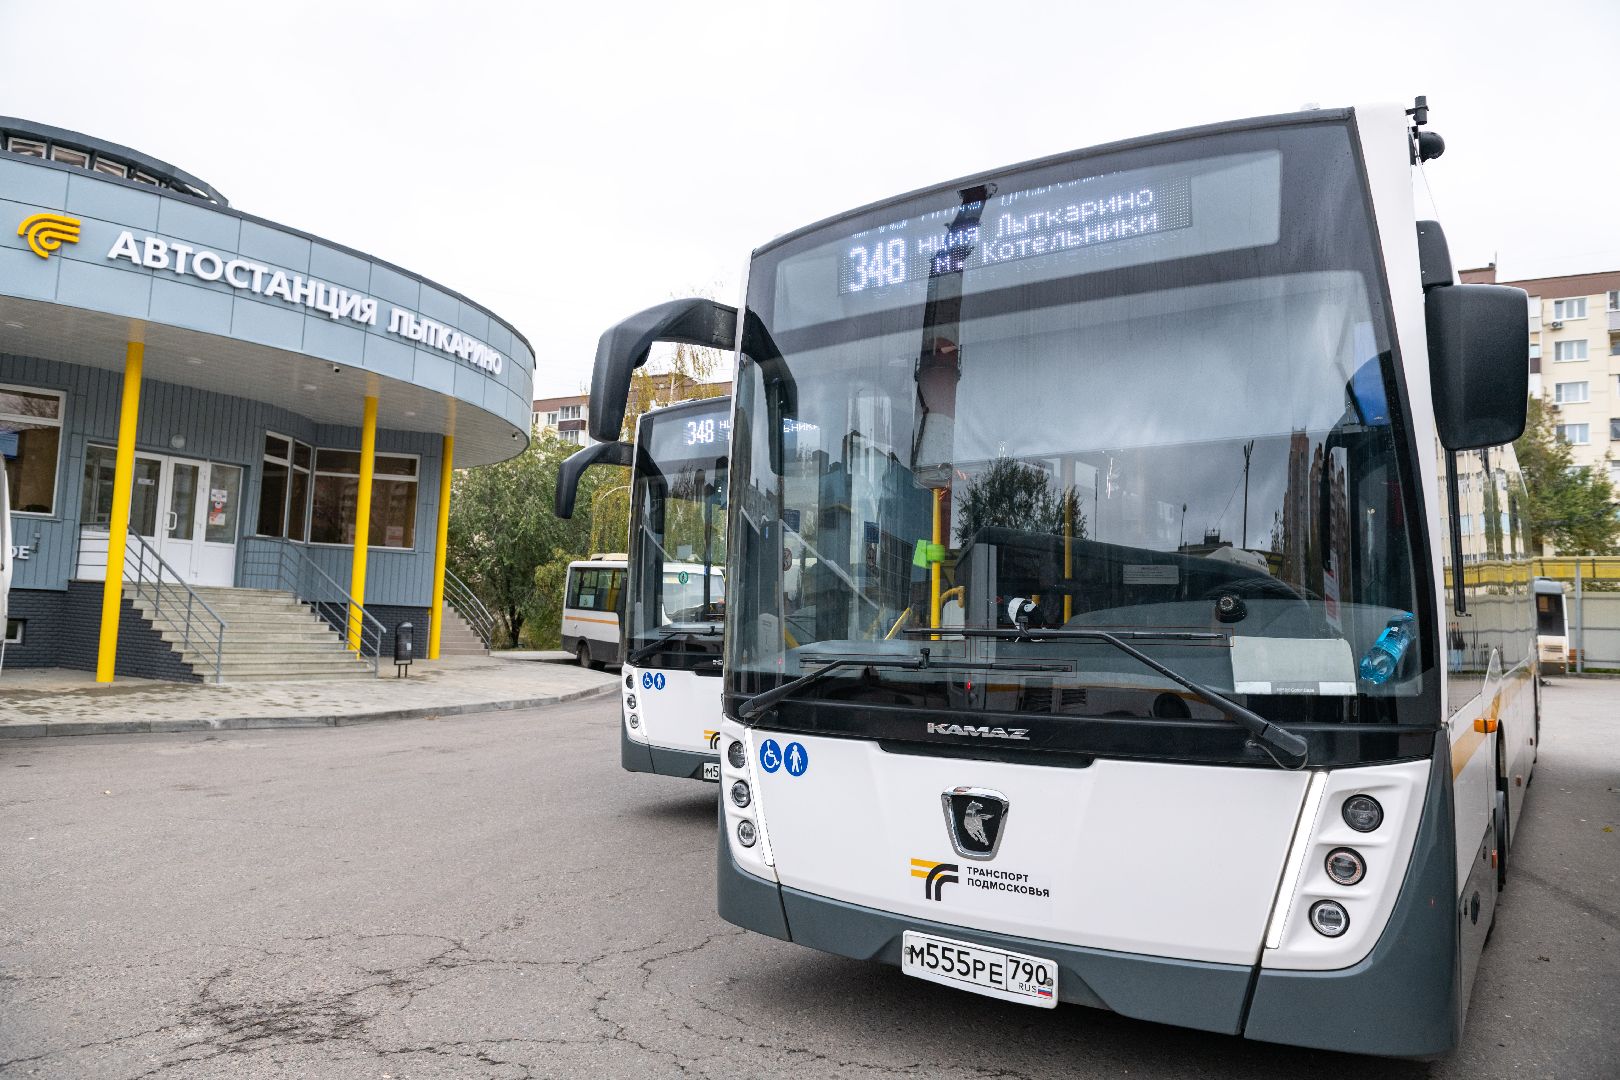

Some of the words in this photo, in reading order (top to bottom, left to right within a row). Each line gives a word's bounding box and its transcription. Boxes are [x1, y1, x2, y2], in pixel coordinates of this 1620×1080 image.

[996, 188, 1154, 238] Лыткарино
[982, 213, 1158, 263] Котельники
[850, 238, 906, 292] 348
[106, 230, 378, 326] АВТОСТАНЦИЯ
[387, 308, 502, 375] ЛЫТКАРИНО
[687, 419, 714, 445] 348
[926, 722, 1031, 741] KAMAZ
[966, 866, 1030, 883] ТРАНСПОРТ
[966, 878, 1050, 898] ПОДМОСКОВЬЯ
[1008, 958, 1048, 986] 790
[1018, 981, 1038, 994] RUS
